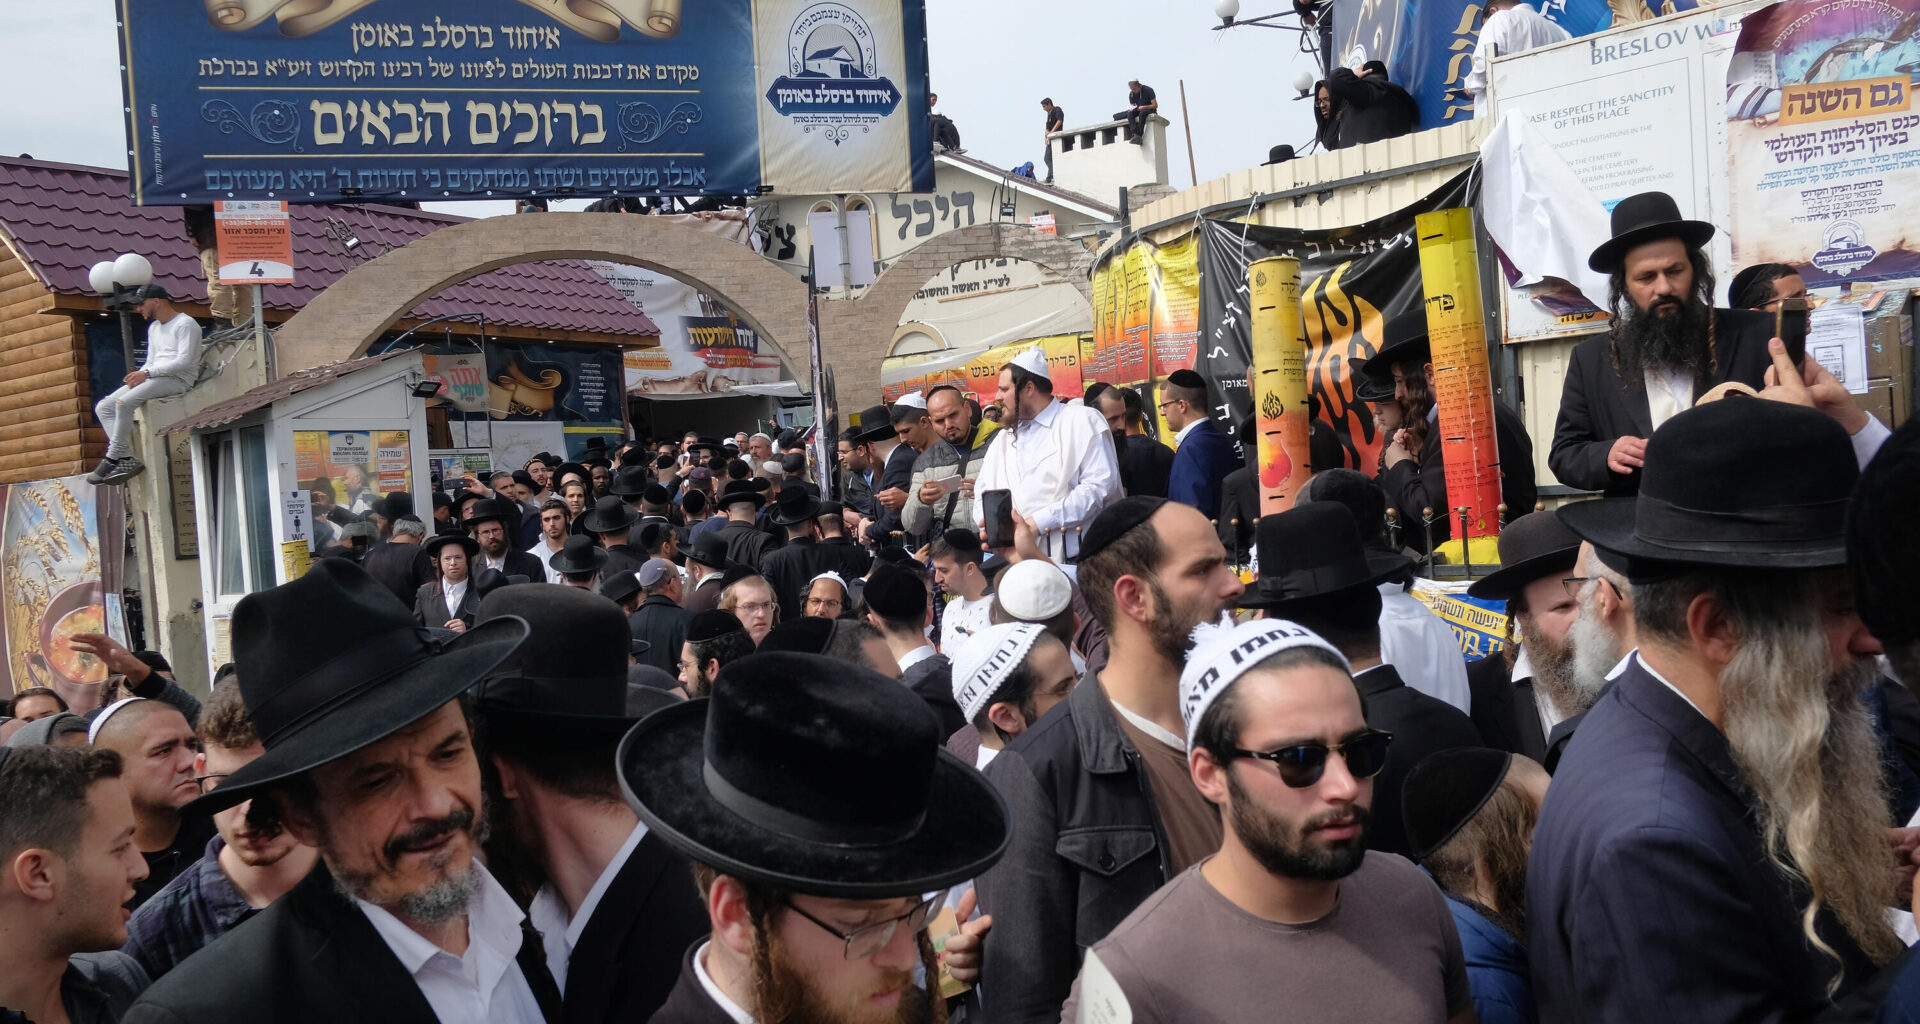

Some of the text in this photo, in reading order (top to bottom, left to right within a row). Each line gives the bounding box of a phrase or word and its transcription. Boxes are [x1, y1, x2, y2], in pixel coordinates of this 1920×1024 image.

[351, 16, 560, 54] איחוד ברסלב באומן
[795, 21, 813, 37] ביחד
[842, 12, 867, 39] תחזיקו
[1591, 27, 1689, 66] BRESLOV
[199, 59, 258, 76] בברכת
[318, 60, 375, 82] הקדוש
[382, 60, 422, 77] רבינו
[428, 56, 454, 78] של
[461, 57, 506, 79] לציונו
[512, 58, 567, 80] העולים
[627, 64, 650, 80] את
[656, 63, 699, 85] מקדם
[777, 83, 891, 109] איחוד ברסלב באומן
[1530, 85, 1675, 123] ASE RESPECT THE SANCTITY
[1788, 82, 1903, 116] גם השנה
[310, 98, 607, 147] ברוכים הבאים
[1554, 106, 1630, 130] OF THIS PLACE
[1764, 114, 1920, 151] כנס הסליחות העולמי
[1574, 156, 1587, 165] THE
[1588, 151, 1622, 163] CEMETERY
[1775, 132, 1908, 163] בציון רבינו הקדוש
[289, 168, 326, 189] היא
[357, 168, 416, 188] חדוות
[422, 168, 441, 188] כי
[534, 168, 583, 187] ושתו
[588, 167, 659, 187] מעדנים
[663, 160, 706, 187] אכלו
[1581, 173, 1604, 183] EFRAIN
[1591, 163, 1605, 173] THE
[205, 169, 284, 190] מעוזכם
[446, 167, 530, 192] ממתקים
[1801, 188, 1828, 199] הקדוש
[891, 192, 974, 240] היכל
[250, 262, 264, 277] 4
[448, 368, 481, 385] אתה
[971, 354, 1077, 379] פדיו נפש
[379, 450, 402, 458] שמירה
[1230, 628, 1309, 666] נחמן
